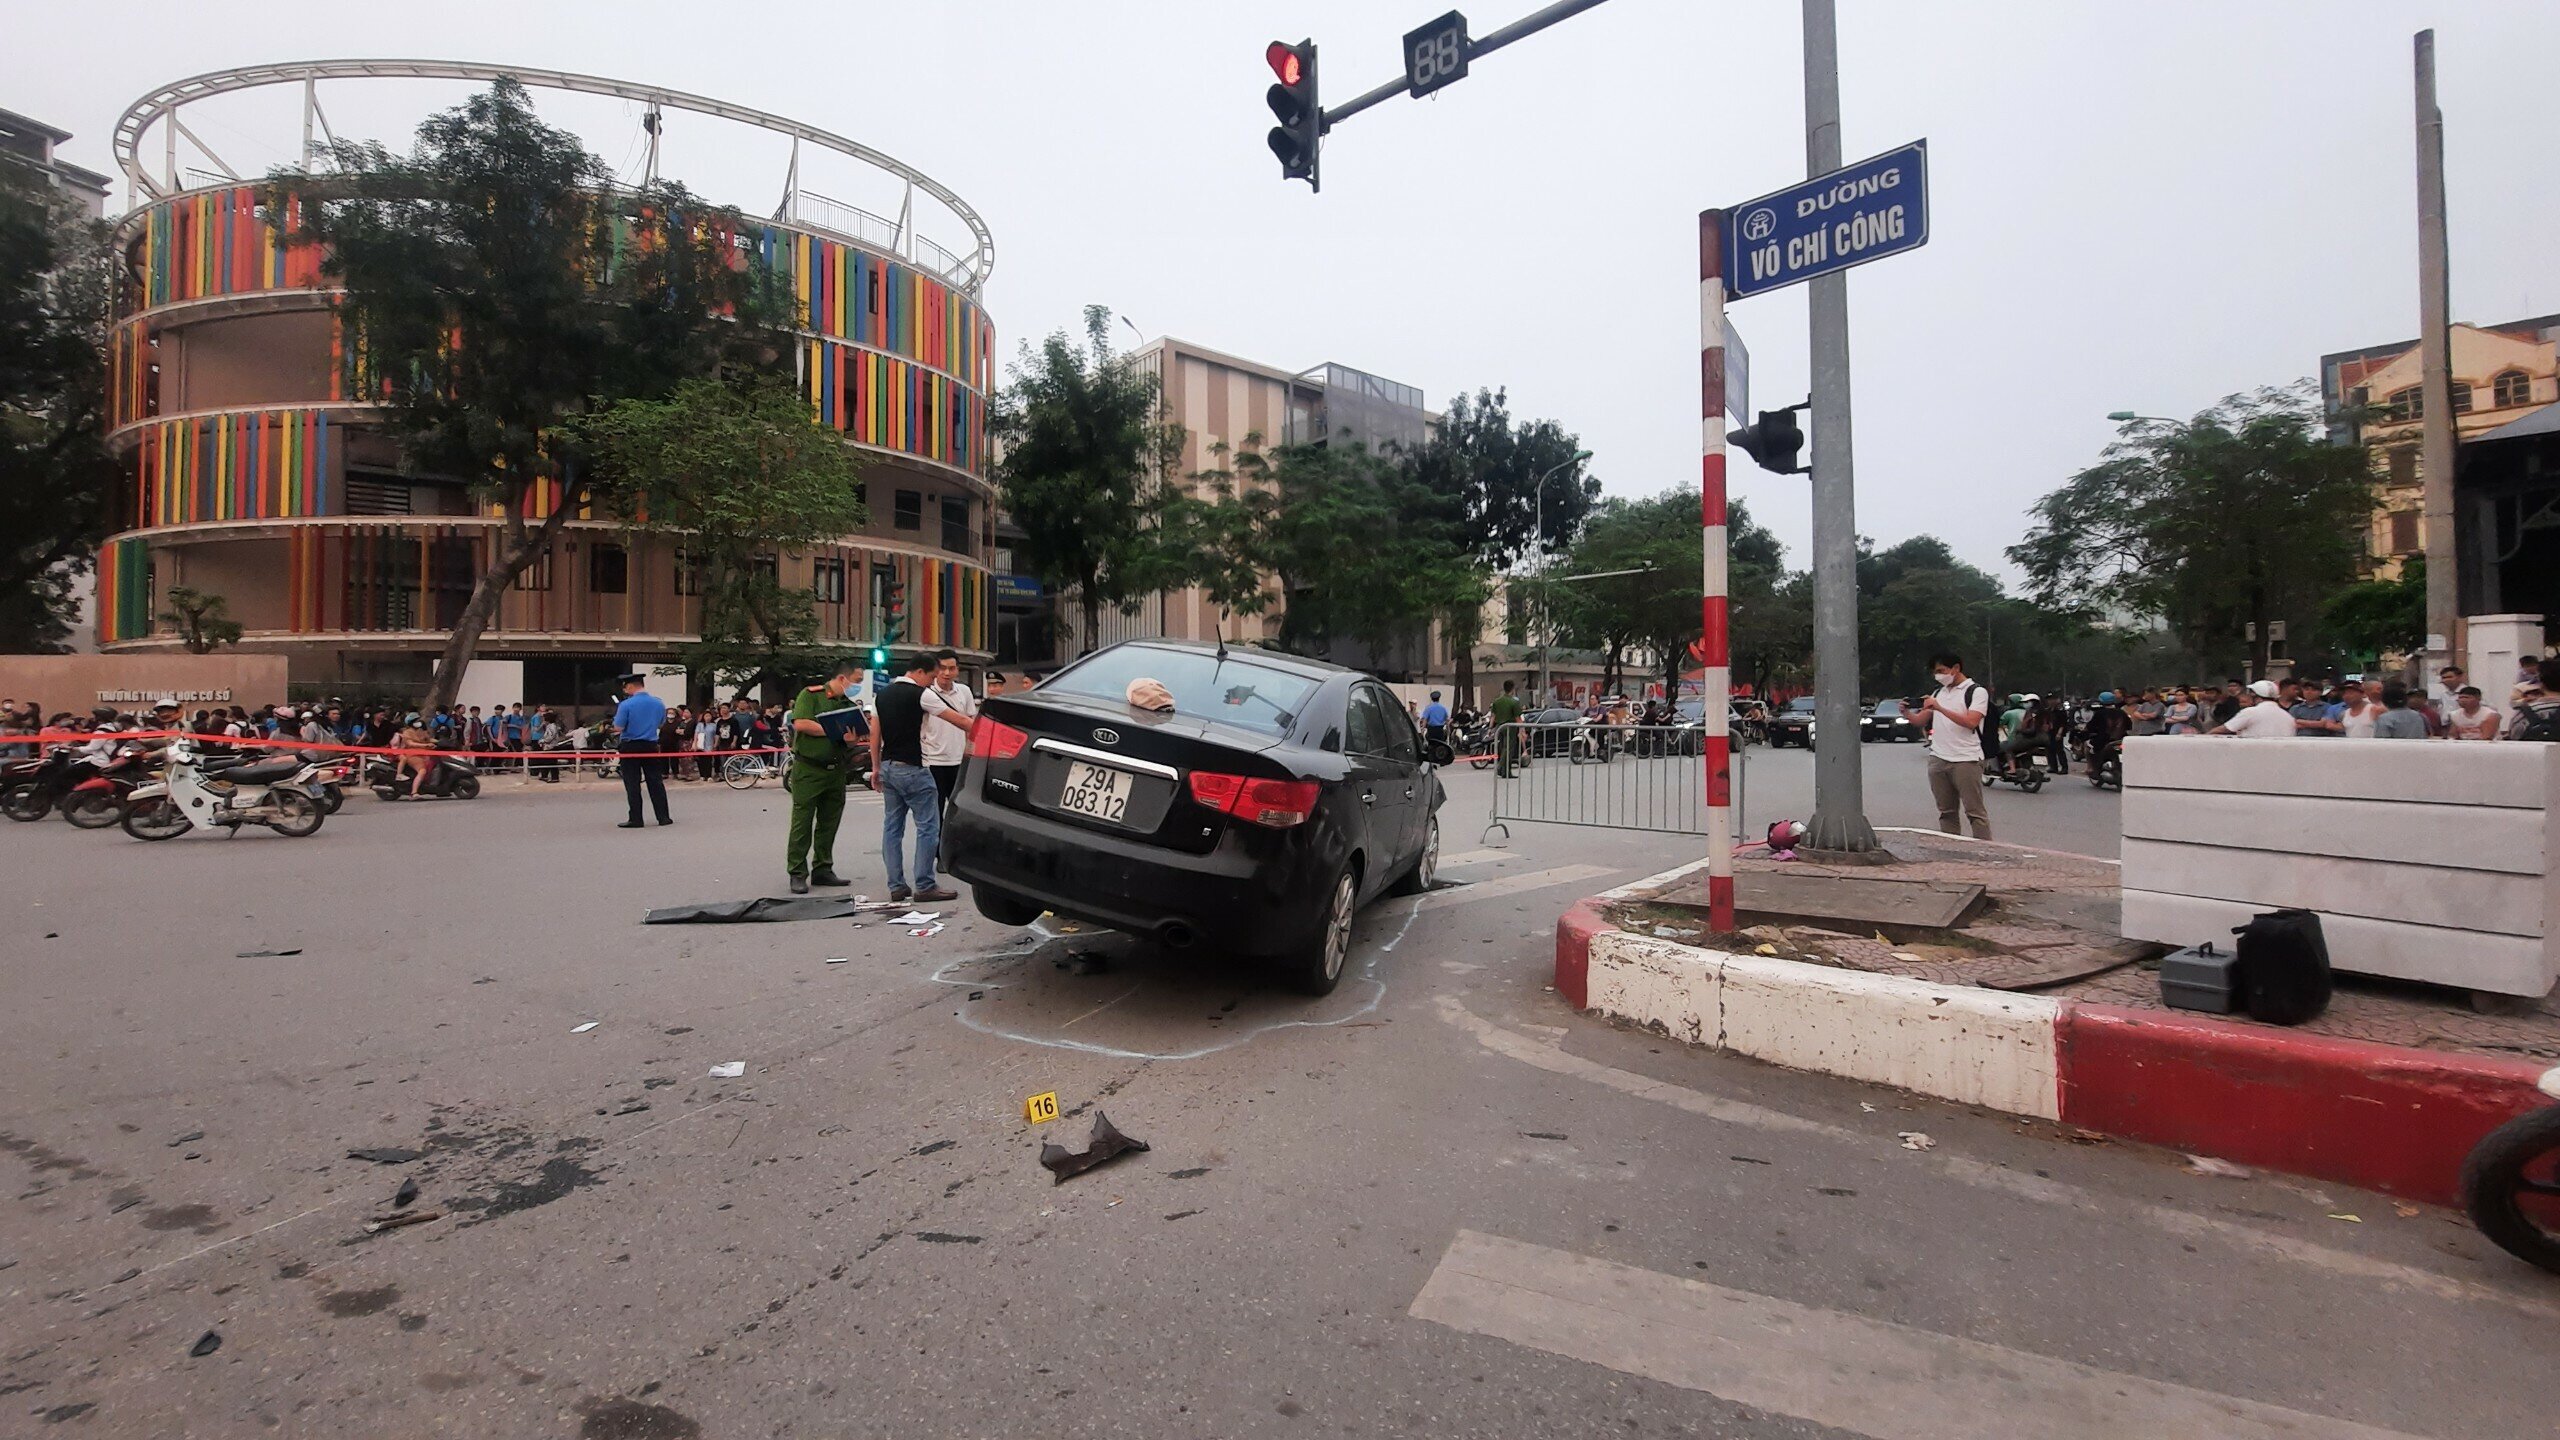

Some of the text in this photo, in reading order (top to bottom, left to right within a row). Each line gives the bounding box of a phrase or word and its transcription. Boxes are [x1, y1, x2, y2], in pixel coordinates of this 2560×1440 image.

[1797, 167, 1901, 219] ĐƯỜNG
[1751, 204, 1905, 281] VÕ CHÍ CÔNG
[1095, 730, 1115, 742] KIA
[991, 778, 1020, 793] FORTE
[1080, 766, 1117, 794] 29A
[1062, 786, 1125, 820] 083.12
[1034, 1097, 1054, 1117] 16
